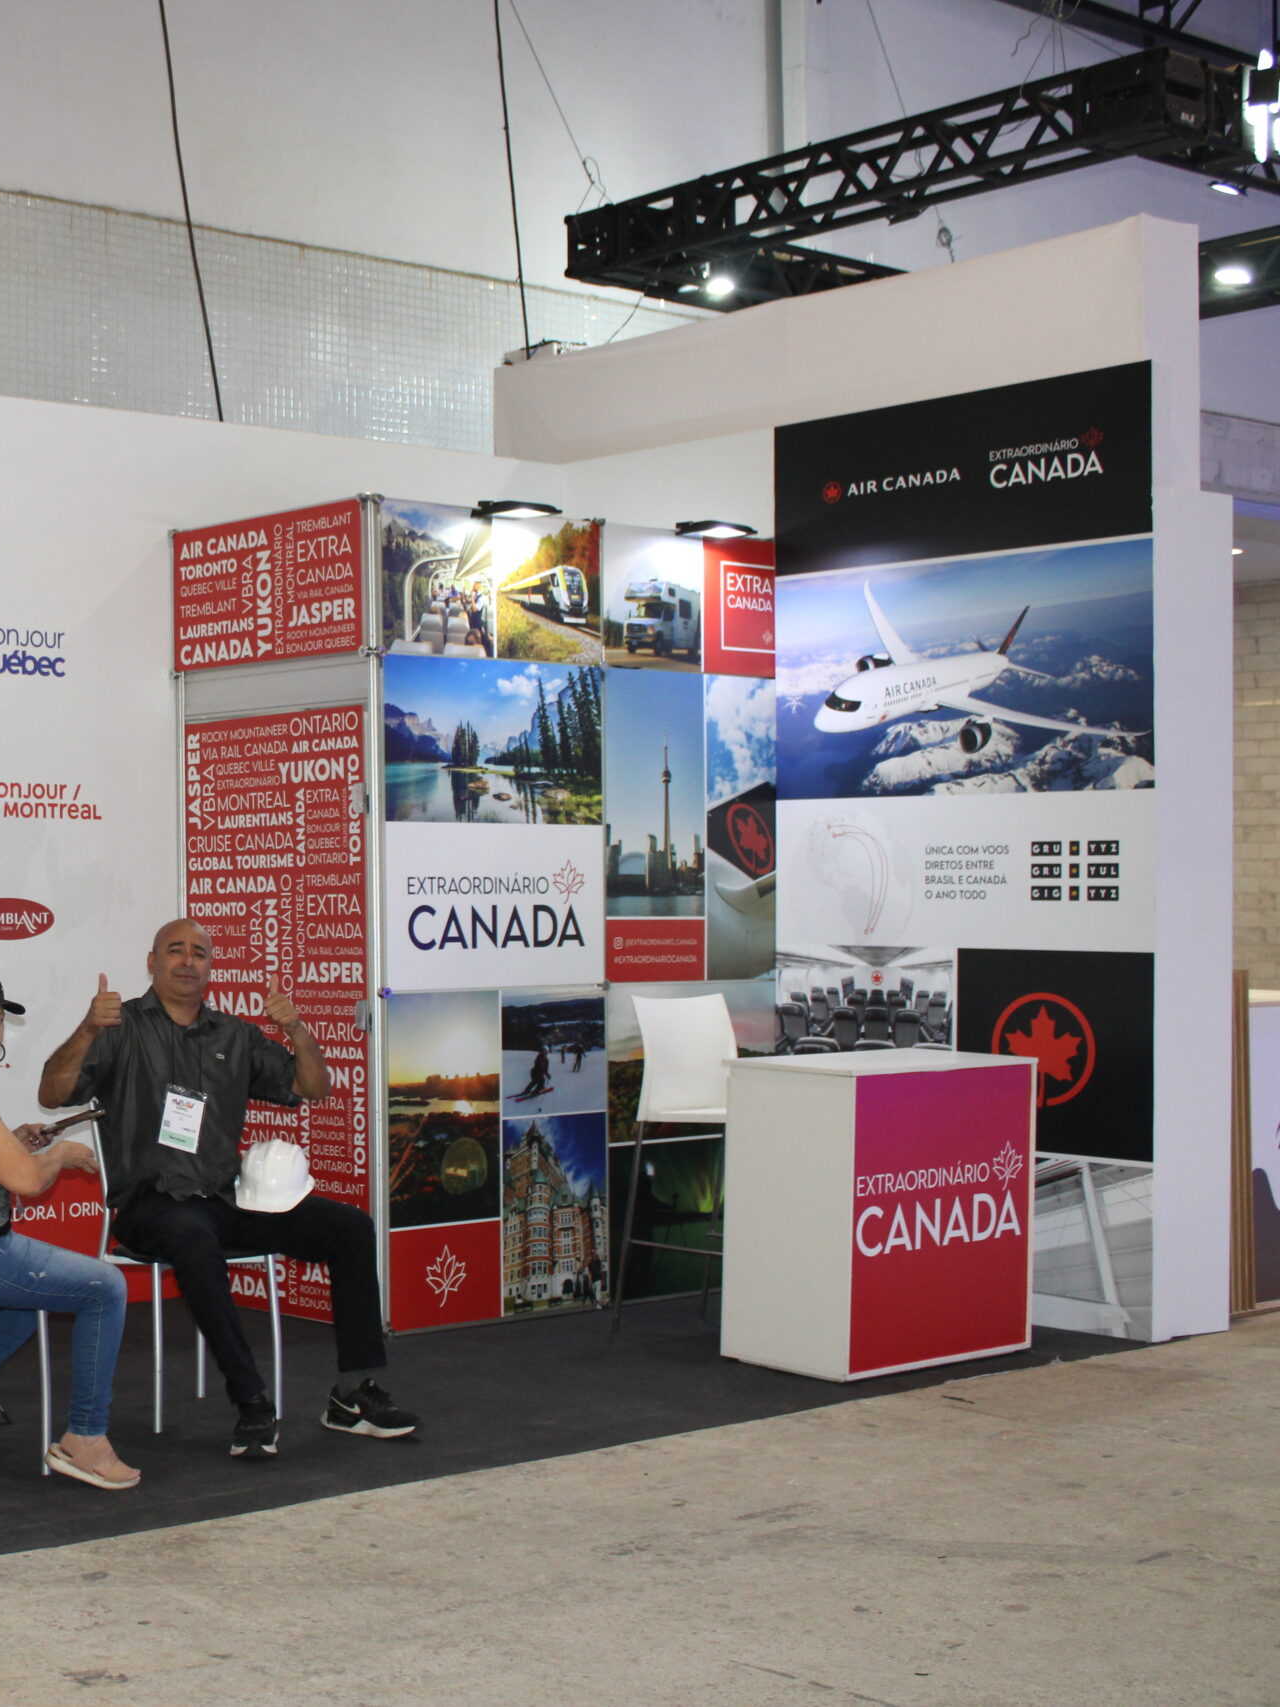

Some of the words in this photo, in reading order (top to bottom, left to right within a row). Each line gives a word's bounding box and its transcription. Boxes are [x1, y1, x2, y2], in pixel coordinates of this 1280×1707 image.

[989, 438, 1079, 462] EXTRAORDINÁRIO
[989, 450, 1104, 489] CANADA
[847, 481, 878, 497] AIR
[882, 467, 962, 492] CANADA
[296, 511, 352, 534] TREMBLANT
[180, 542, 203, 561] AIR
[207, 529, 269, 555] CANADA
[297, 534, 352, 563] EXTRA
[180, 558, 238, 581] TORONTO
[286, 522, 295, 604] MONTREAL
[296, 562, 354, 586] CANADA
[180, 581, 213, 598] QUEBEC
[215, 577, 237, 591] VILLE
[241, 554, 254, 614] VBRA
[297, 590, 309, 600] VIA
[309, 588, 323, 599] RAIL
[325, 583, 354, 596] CANADA
[726, 572, 773, 596] EXTRA
[180, 597, 238, 619] TREMBLANT
[256, 550, 273, 657] YUKON
[288, 597, 357, 629] JASPER
[726, 594, 773, 613] CANADA
[180, 617, 254, 640] LAURENTIANS
[286, 629, 309, 640] ROCKY
[309, 622, 356, 637] MOUNTAINEER
[180, 637, 254, 666] CANADA
[286, 638, 323, 653] BONJOUR
[324, 635, 356, 650] QUEBEC
[884, 685, 902, 699] AIR
[903, 676, 937, 694] CANADA
[201, 731, 228, 743] ROCKY
[229, 723, 288, 740] MOUNTAINEER
[289, 711, 359, 737] ONTARIO
[202, 747, 219, 760] VIA
[220, 746, 242, 759] RAIL
[244, 741, 288, 758] CANADA
[291, 741, 309, 754] AIR
[312, 735, 359, 752] CANADA
[216, 762, 251, 776] QUEBEC
[252, 759, 275, 772] VILLE
[278, 757, 345, 784] YUKON
[187, 732, 201, 830] JASPER
[202, 764, 216, 831] VBRA
[217, 790, 291, 812] MONTREAL
[306, 788, 340, 804] EXTRA
[217, 811, 294, 830] LAURENTIANS
[306, 809, 341, 820] CANADA
[295, 787, 306, 868] CANADA
[306, 822, 341, 834] BONJOUR
[188, 834, 232, 854] CRUISE
[235, 831, 294, 851] CANADA
[307, 836, 341, 850] QUEBEC
[924, 843, 954, 855] ÚNICA
[956, 846, 979, 855] COM
[981, 845, 1010, 855] VOOS
[1032, 844, 1061, 854] GRU
[1089, 843, 1117, 854] YYZ
[188, 856, 233, 871] GLOBAL
[236, 853, 294, 869] TOURISME
[307, 851, 348, 865] ONTARIO
[924, 859, 964, 870] DIRETOS
[966, 859, 995, 870] ENTRE
[306, 872, 362, 887] TREMBLANT
[924, 875, 956, 885] BRASIL
[958, 875, 963, 885] E
[1032, 866, 1061, 876] GRU
[1089, 866, 1117, 876] YUL
[189, 878, 212, 895] AIR
[216, 876, 277, 894] CANADA
[407, 872, 550, 895] EXTRAORDINÁRIO
[1032, 888, 1061, 898] GIG
[1089, 888, 1117, 898] YYZ
[924, 889, 933, 900] O
[935, 889, 957, 900] ANO
[958, 889, 987, 900] TODO
[190, 902, 247, 917] TORONTO
[306, 894, 362, 916] EXTRA
[295, 874, 305, 958] MONTREAL
[224, 925, 247, 937] VILLE
[250, 900, 263, 964] VBRA
[306, 922, 363, 940] CANADA
[408, 904, 586, 951] CANADA
[307, 948, 318, 956] VIA
[320, 948, 334, 956] RAIL
[334, 947, 364, 956] CANADA
[208, 969, 264, 983] RENTIANS
[297, 961, 364, 984] JASPER
[295, 990, 317, 999] ROCKY
[319, 991, 363, 1000] MOUNTAINEER
[295, 1004, 332, 1015] BONJOUR
[311, 1115, 345, 1127] CANADA
[353, 1065, 366, 1177] TORONTO
[311, 1129, 346, 1141] BONJOUR
[312, 1143, 346, 1157] QUEBEC
[312, 1158, 353, 1174] ONTARIO
[314, 1179, 365, 1196] REMBLANT
[856, 1160, 990, 1197] EXTRAORDINÁRIO
[856, 1190, 1022, 1257] CANADA
